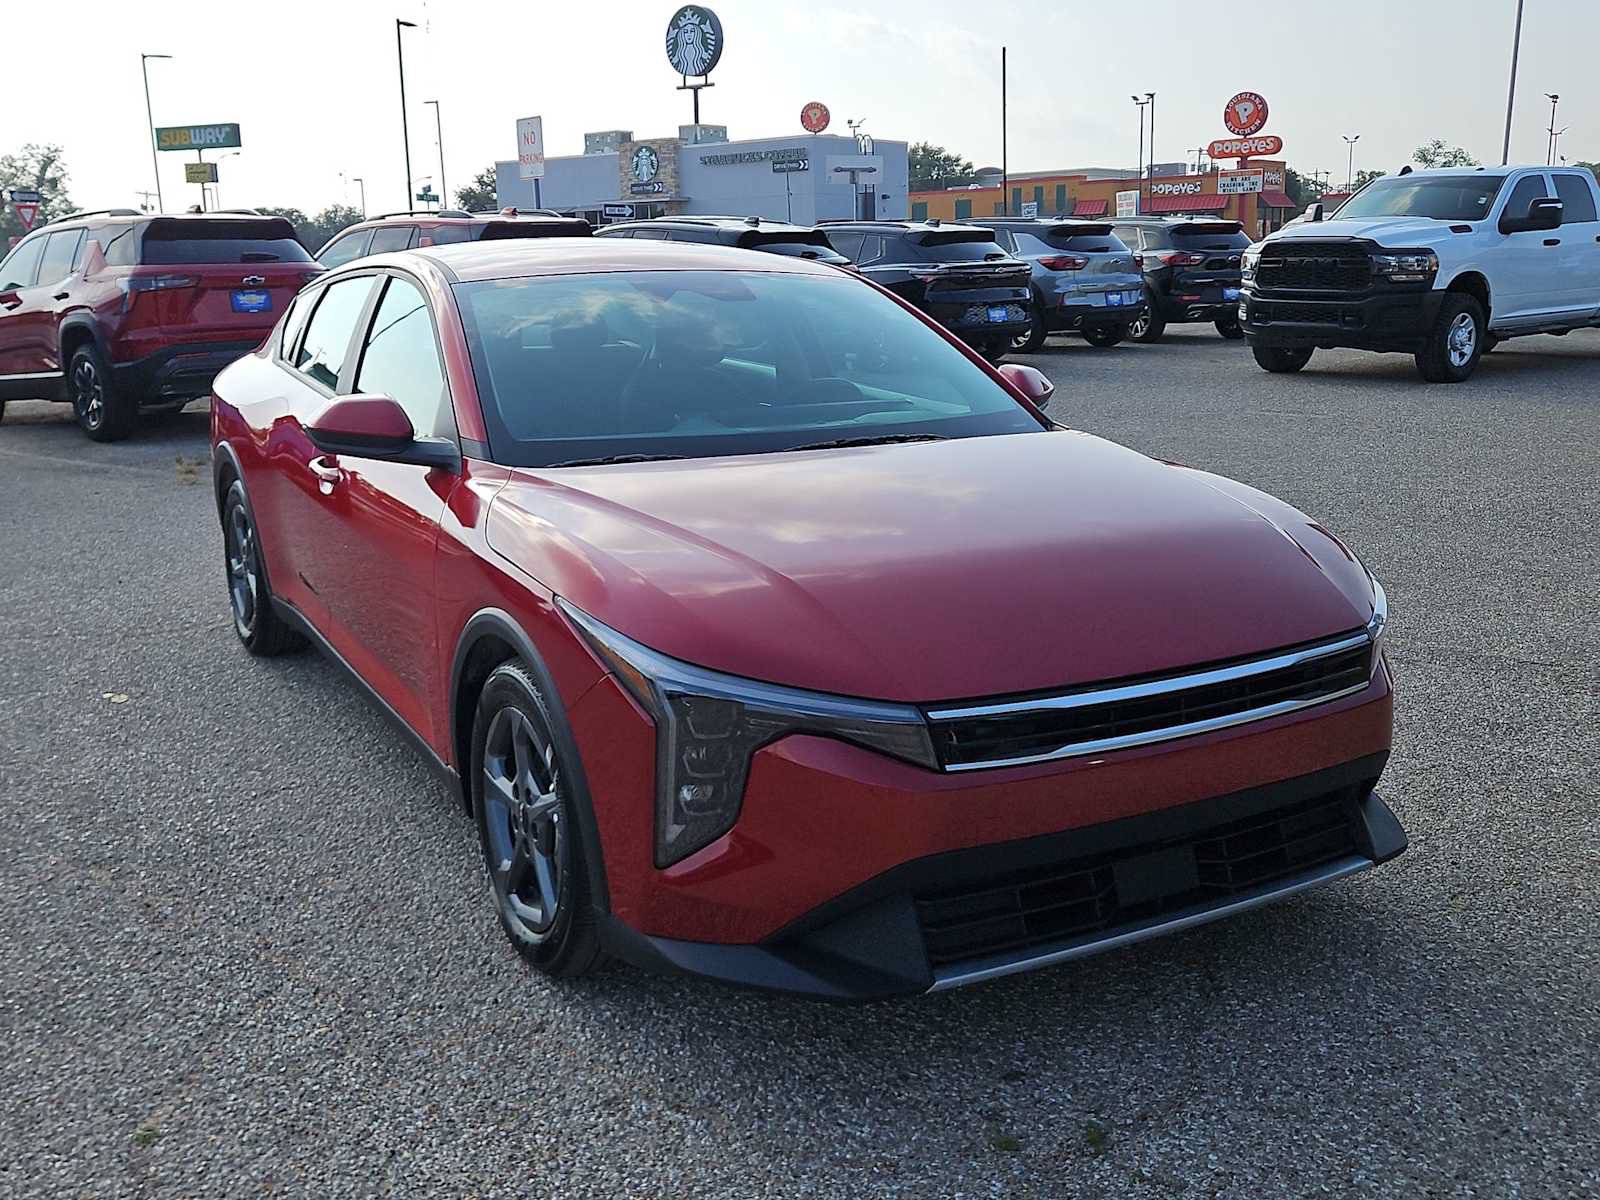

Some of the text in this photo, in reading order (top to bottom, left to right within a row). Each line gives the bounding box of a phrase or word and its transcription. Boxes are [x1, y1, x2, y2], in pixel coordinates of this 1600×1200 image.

[160, 127, 226, 145] SUBWAY
[523, 131, 536, 145] NO
[519, 153, 544, 165] PARKING
